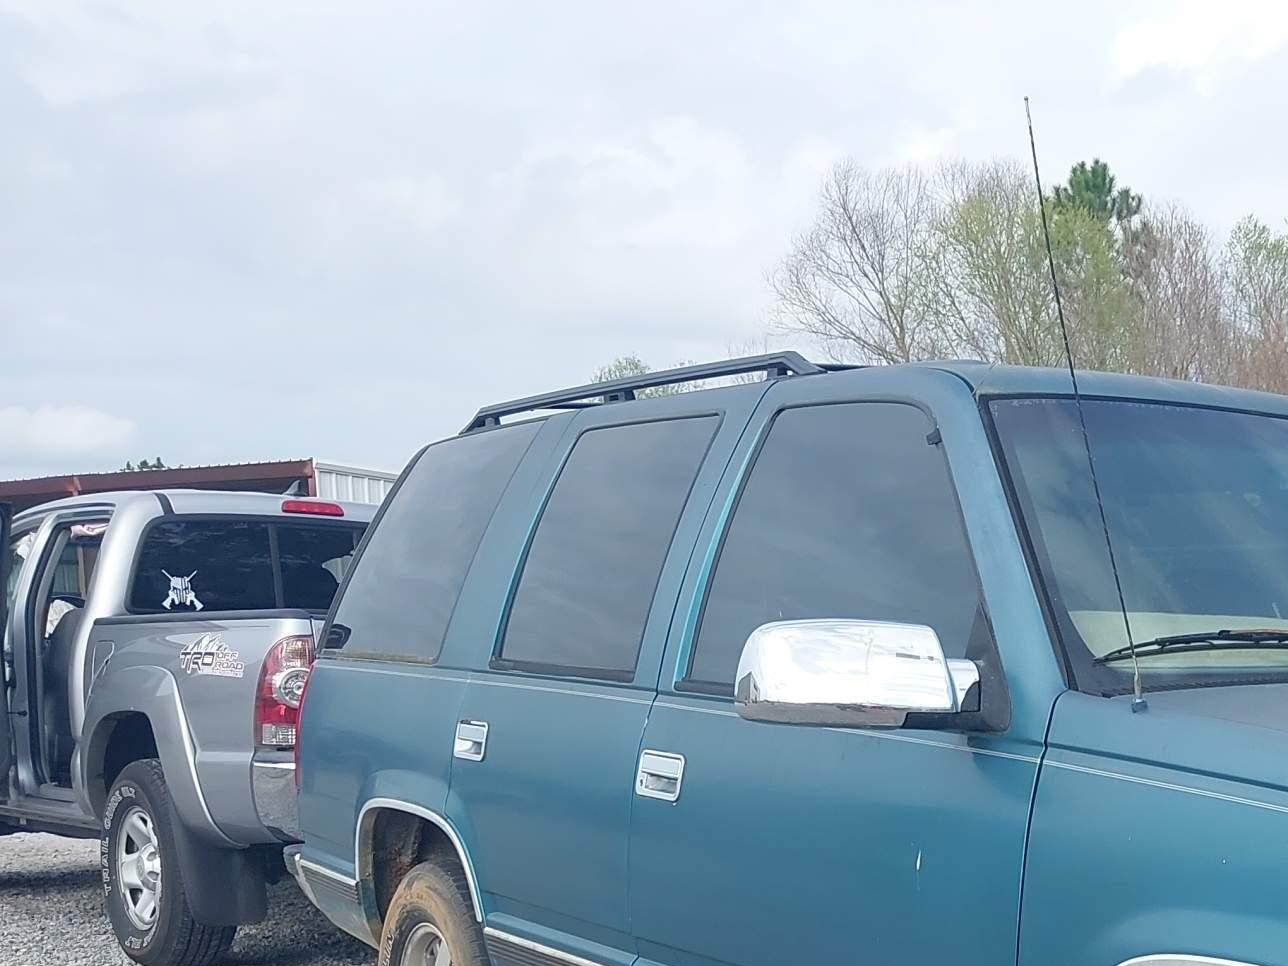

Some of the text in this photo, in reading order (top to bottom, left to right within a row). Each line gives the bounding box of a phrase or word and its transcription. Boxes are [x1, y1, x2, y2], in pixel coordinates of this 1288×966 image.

[181, 652, 214, 672] TRD
[214, 661, 243, 670] ROAD
[101, 837, 112, 896] TRAIL
